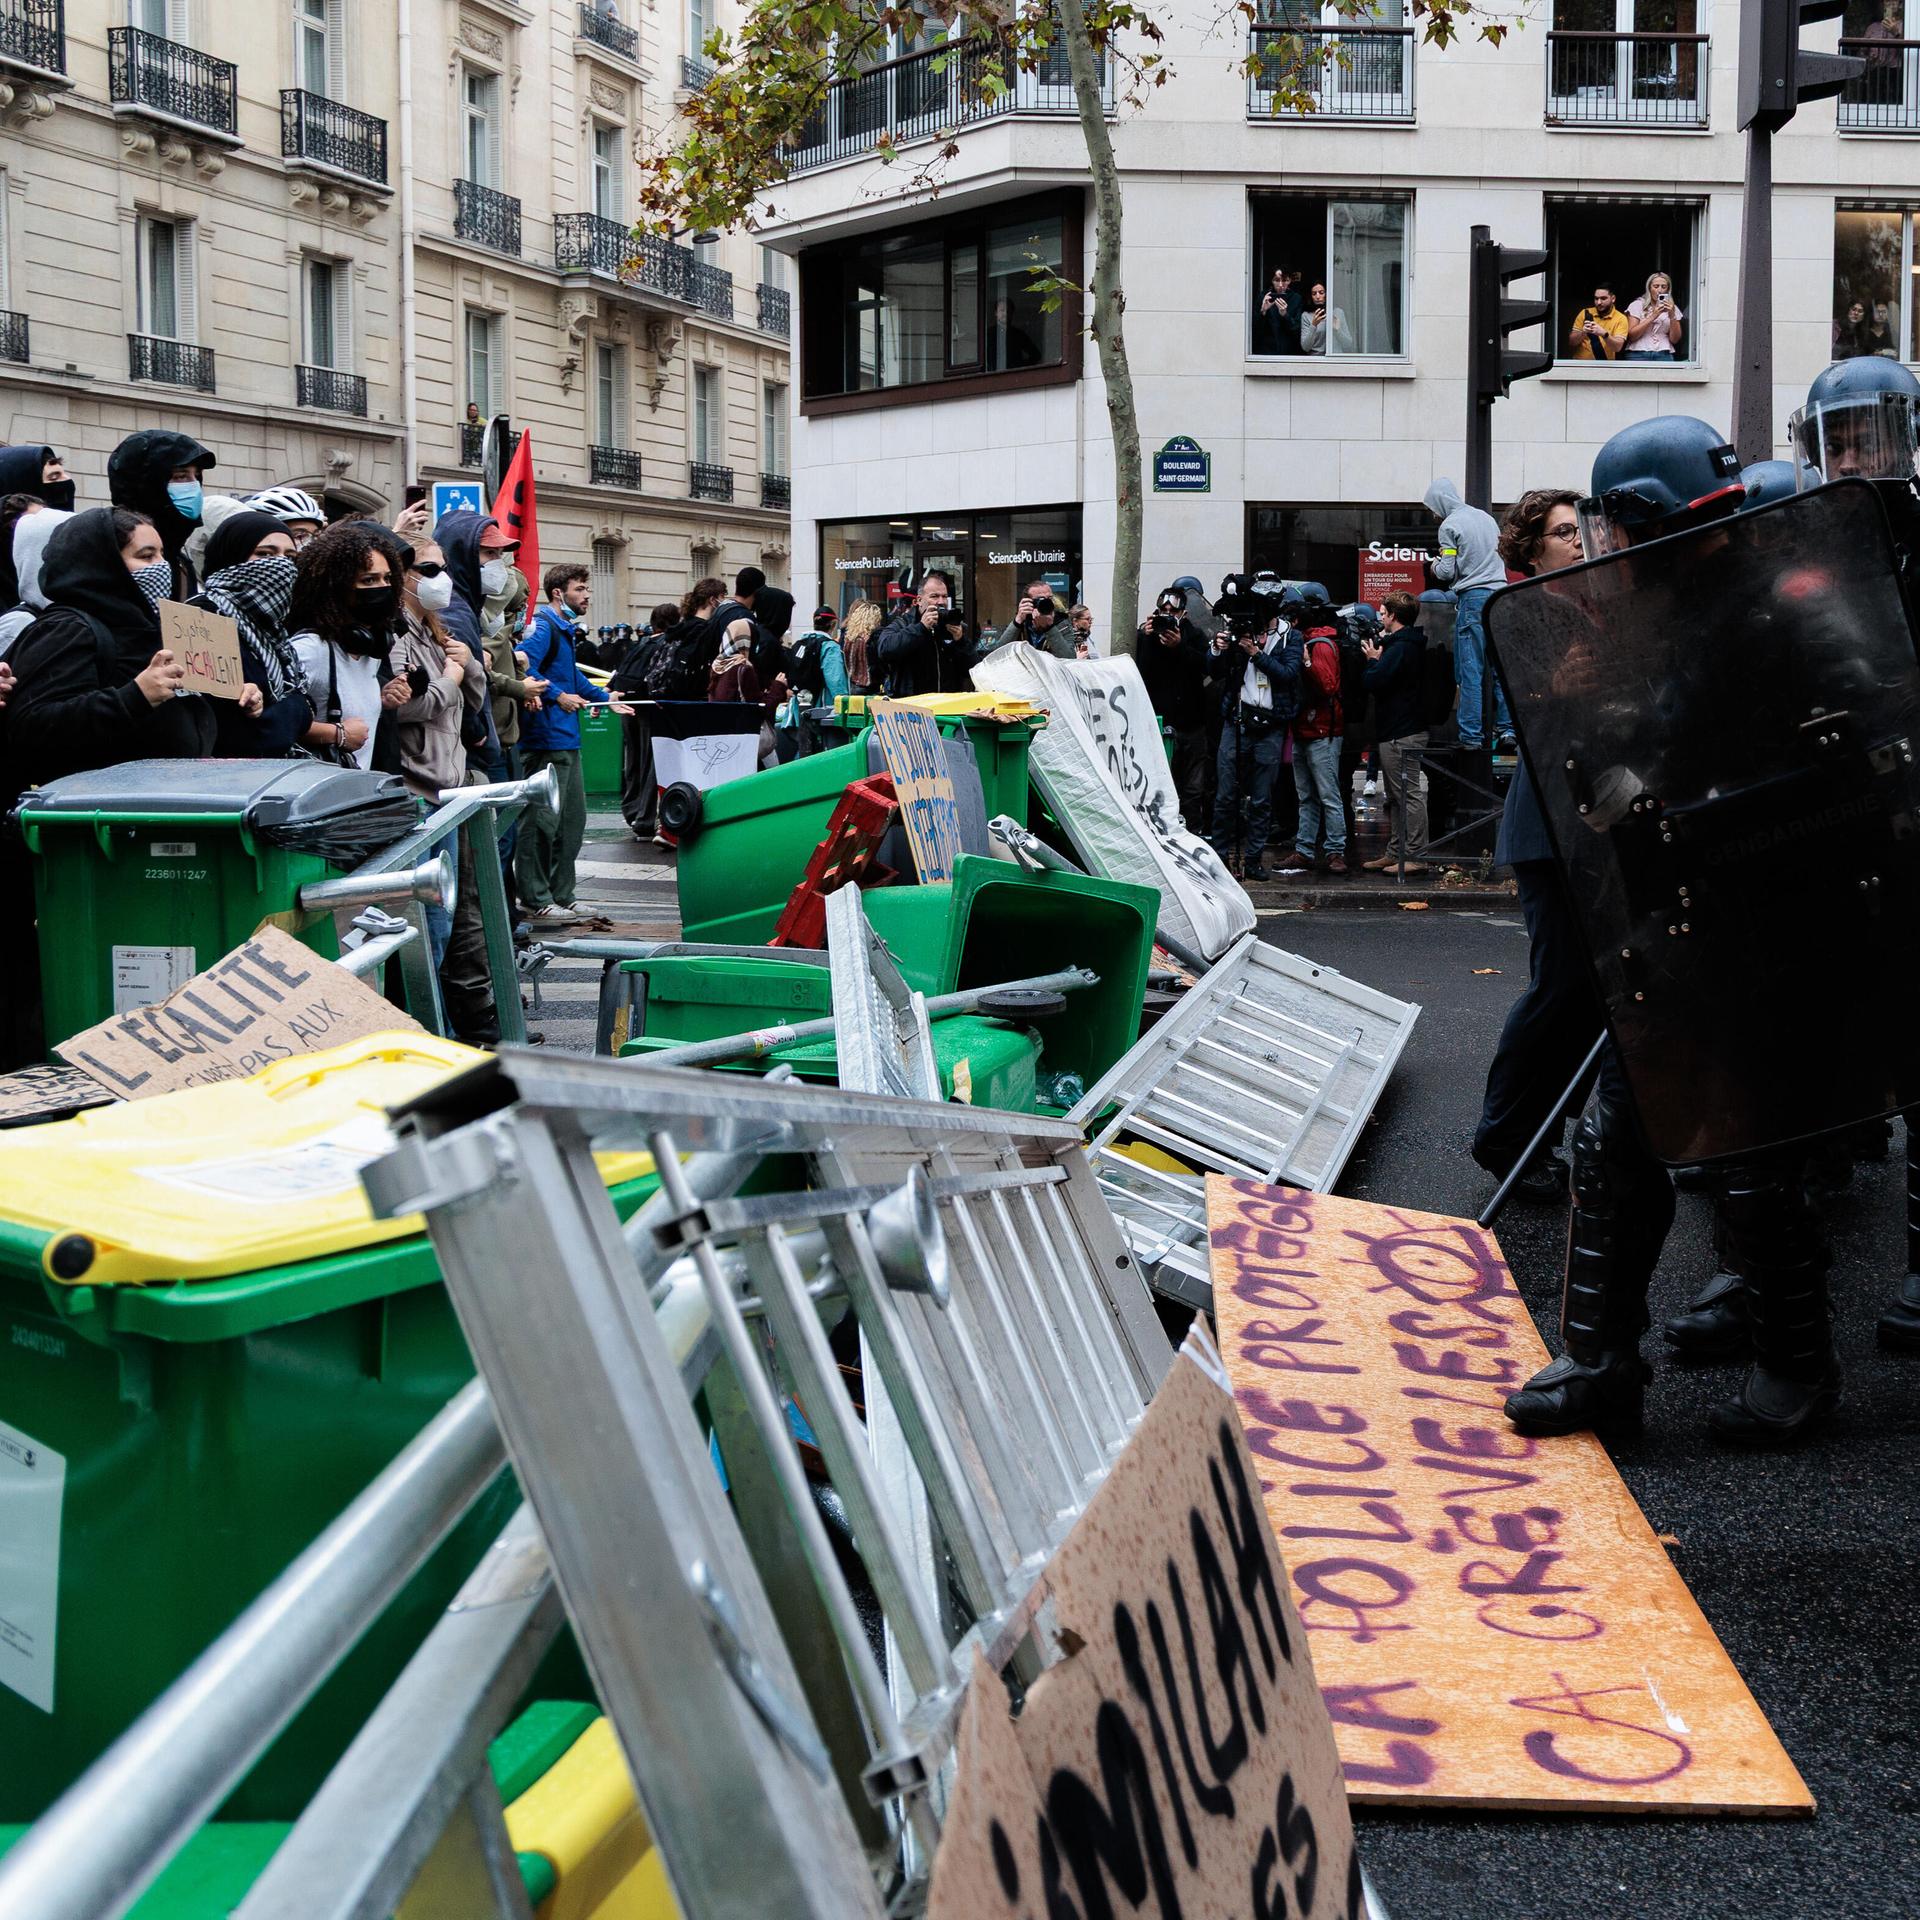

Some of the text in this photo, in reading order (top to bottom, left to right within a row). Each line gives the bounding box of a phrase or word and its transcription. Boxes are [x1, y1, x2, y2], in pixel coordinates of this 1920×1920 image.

[1163, 462, 1201, 470] BOULEVARD
[1158, 474, 1206, 482] SAINT-GERMAIN
[835, 556, 900, 570] SciencesPo Librairie
[988, 549, 1066, 565] SciencesPo Librairie
[1704, 793, 1882, 866] GENDARMERIE
[145, 868, 208, 880] 2236011247
[240, 1035, 294, 1077] PAS
[288, 997, 345, 1049] AUX
[1322, 1681, 1443, 1787] LA
